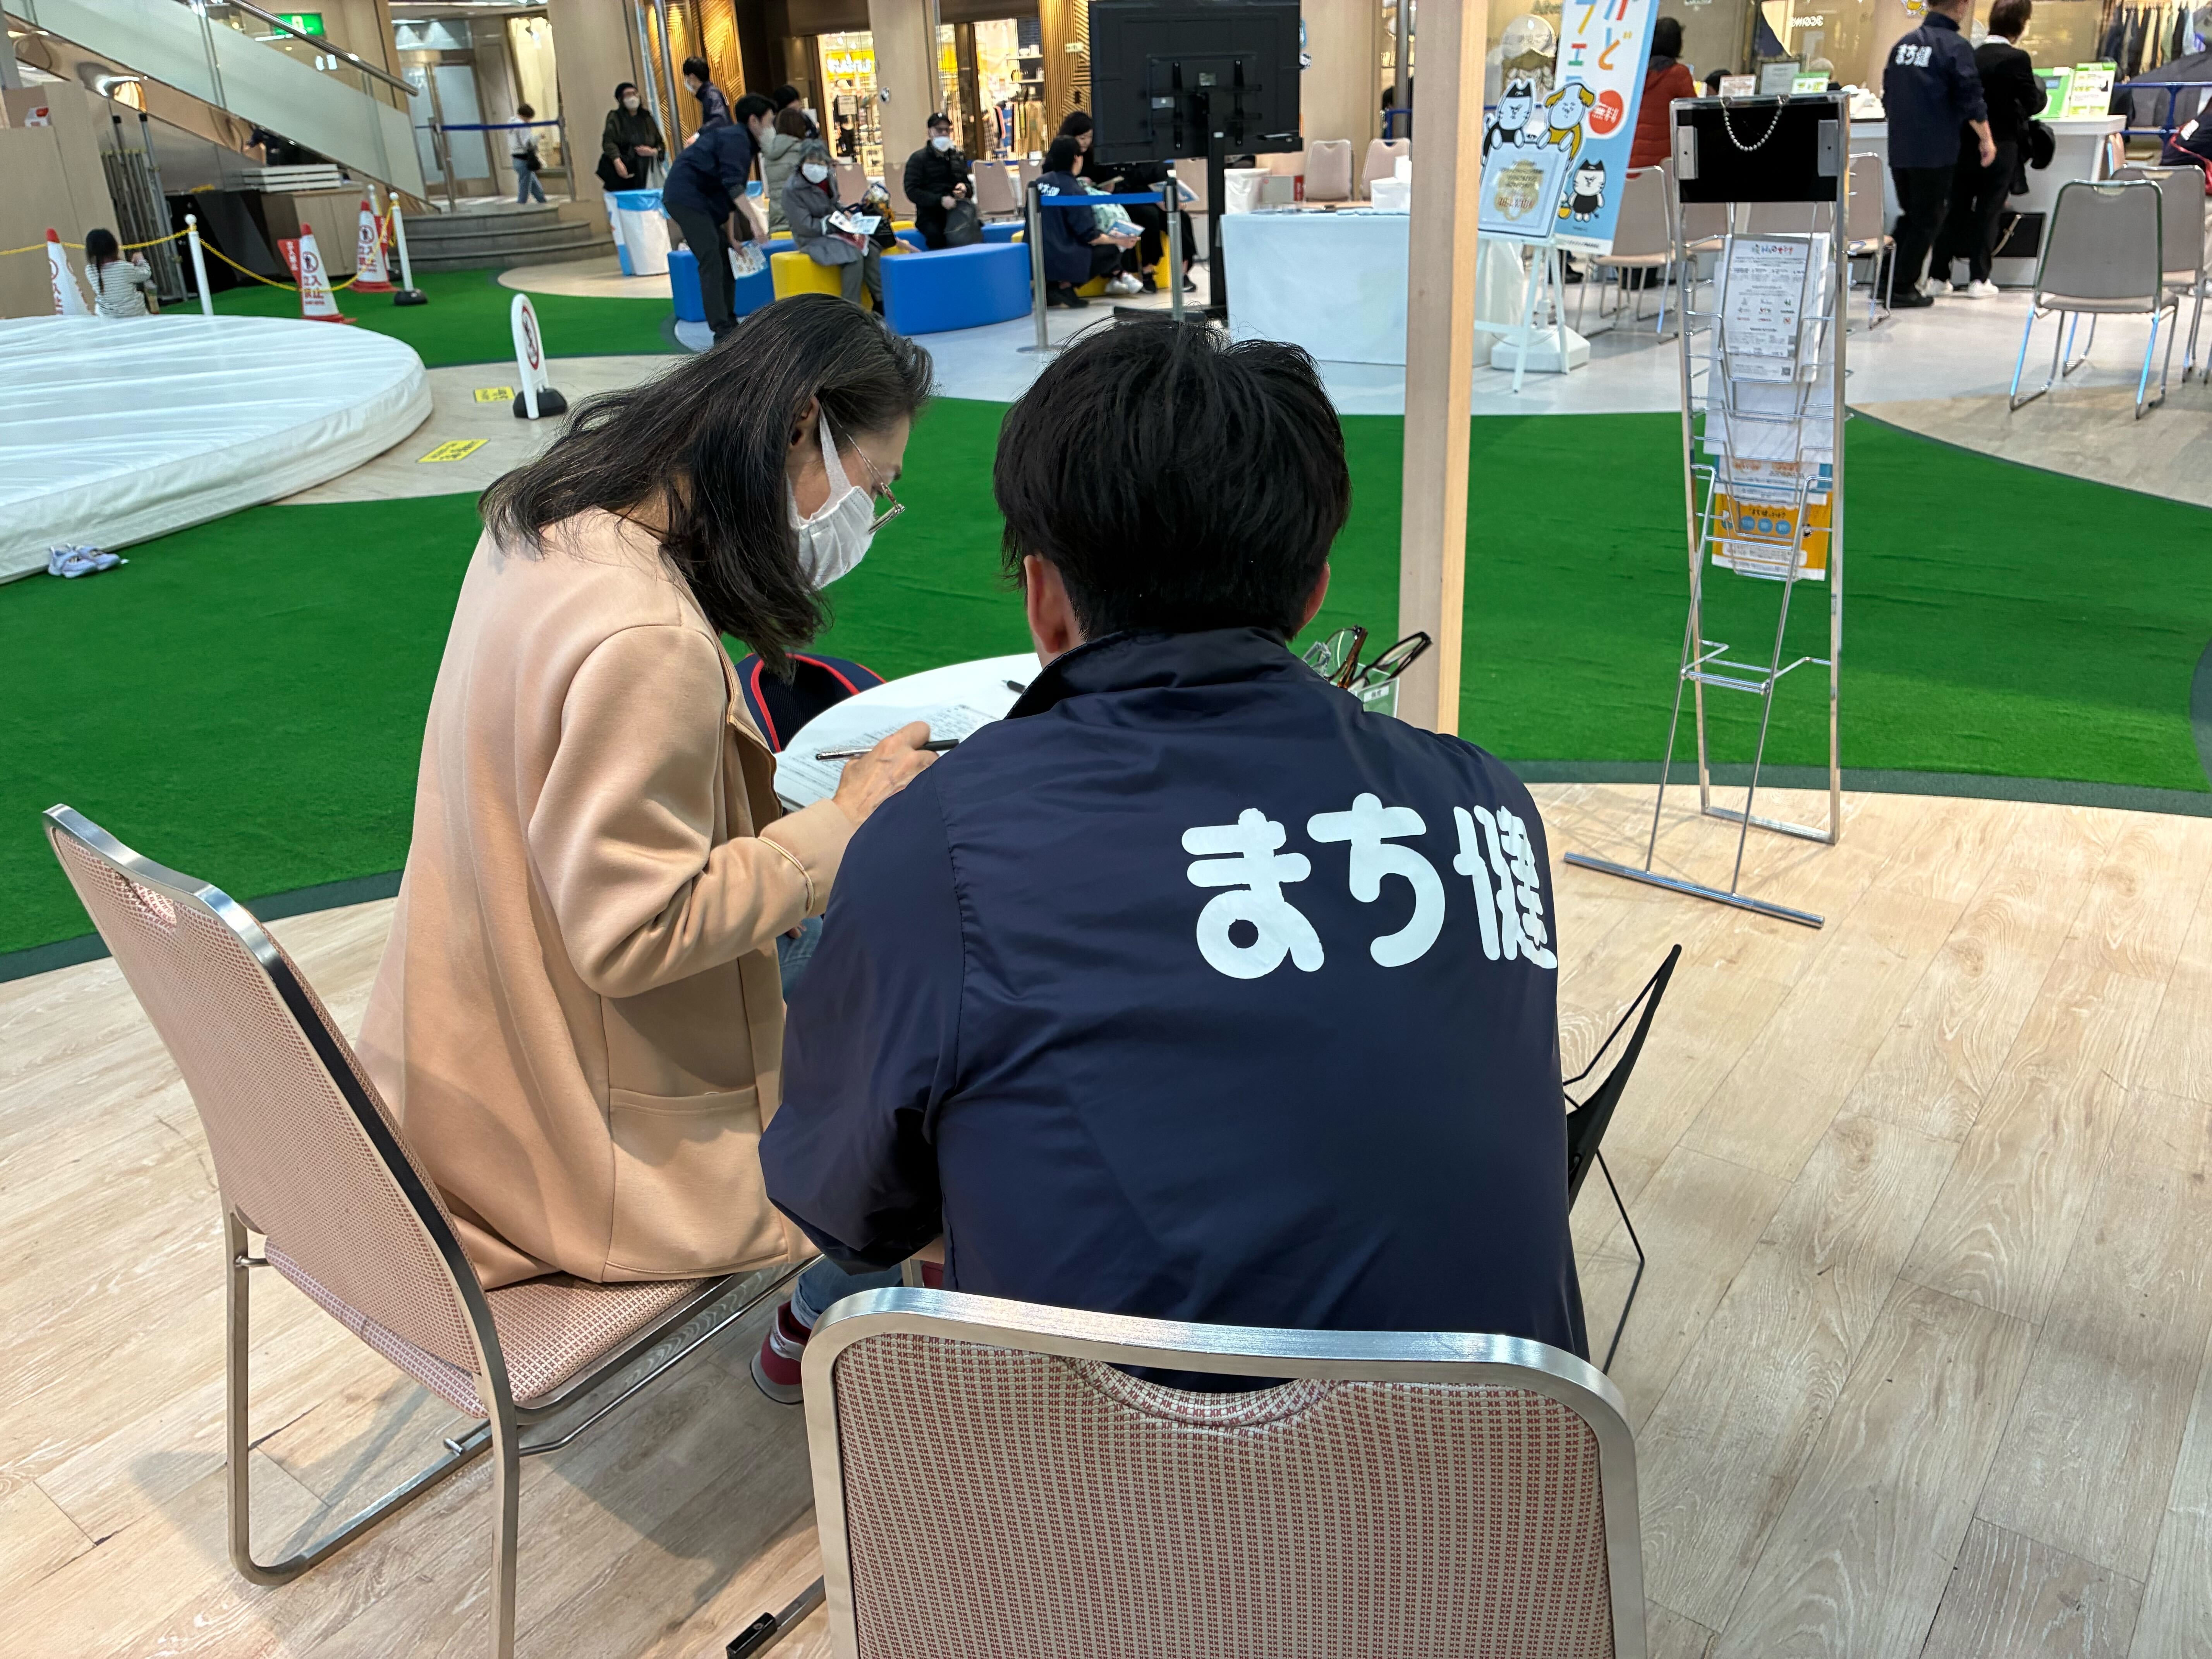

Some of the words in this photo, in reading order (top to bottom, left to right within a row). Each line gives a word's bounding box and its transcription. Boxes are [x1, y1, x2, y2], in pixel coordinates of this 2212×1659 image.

[1592, 102, 1619, 123] 無料
[1182, 792, 1557, 979] まち健
